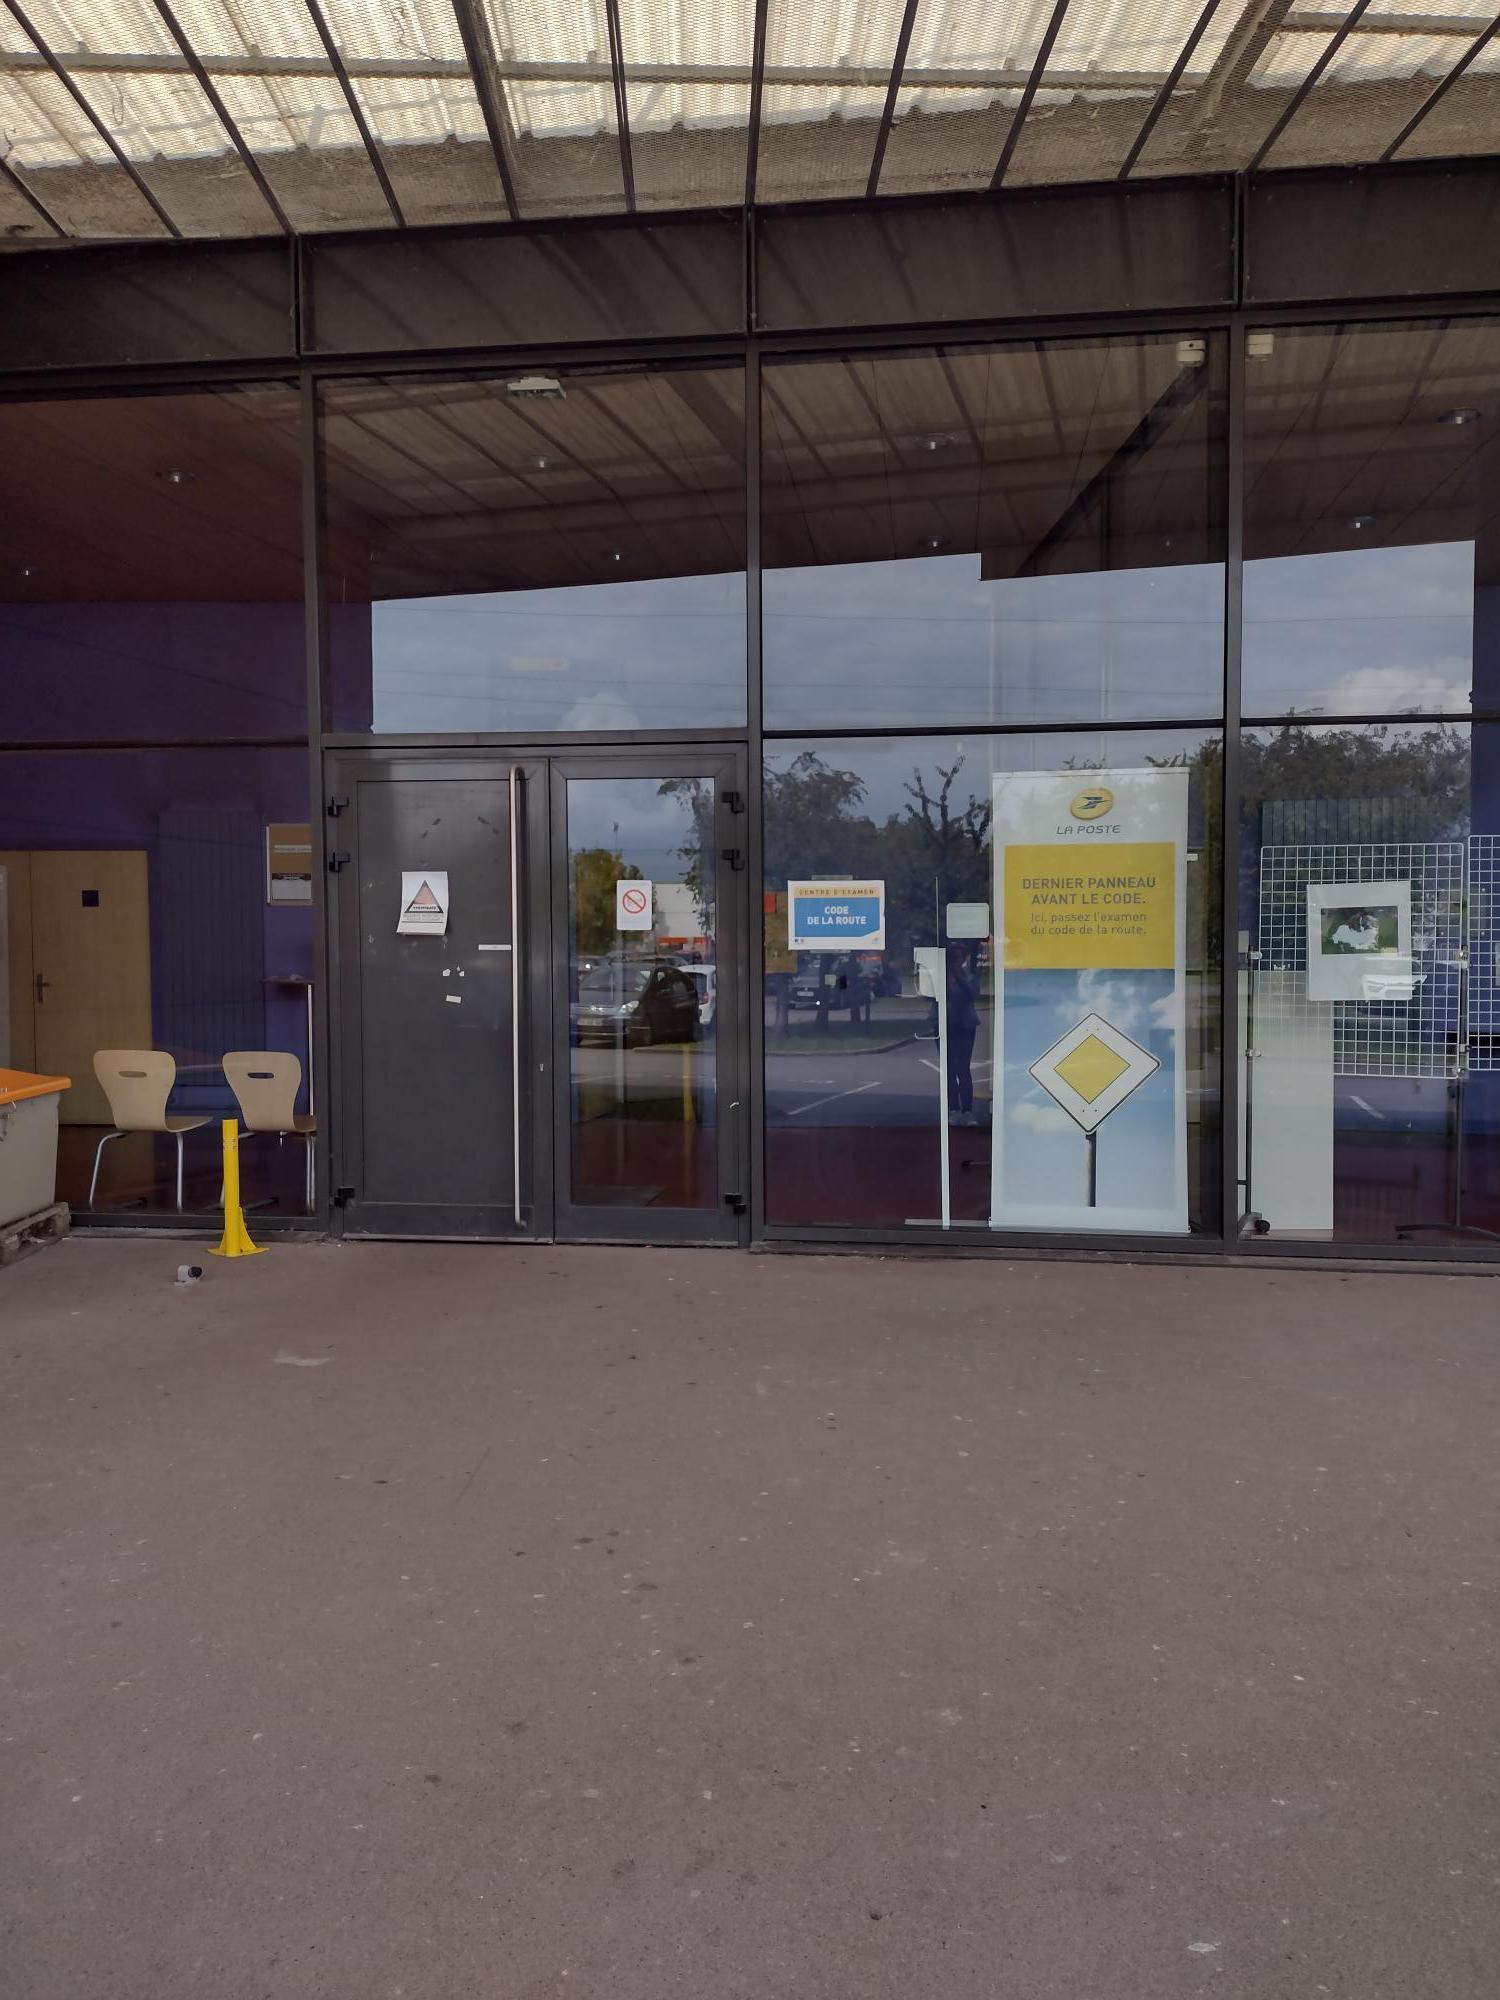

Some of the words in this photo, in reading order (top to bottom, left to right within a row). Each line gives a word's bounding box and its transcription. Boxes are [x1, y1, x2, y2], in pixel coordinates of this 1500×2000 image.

[1056, 825, 1073, 835] LA
[1077, 824, 1121, 835] POSTE
[1022, 877, 1084, 889] DERNIER
[1088, 877, 1156, 889] PANNEAU
[1031, 893, 1077, 905] AVANT
[1082, 893, 1099, 905] LE
[1103, 893, 1146, 905] CODE.
[824, 906, 849, 914] CODE
[807, 916, 820, 925] DE
[821, 916, 834, 925] LA
[835, 916, 867, 925] ROUTE
[1051, 913, 1090, 924] passez
[1094, 911, 1147, 922] l'examen
[1031, 925, 1045, 935] du
[1048, 925, 1076, 935] code
[1079, 925, 1093, 935] de
[1097, 925, 1108, 935] la
[1111, 925, 1147, 935] route.
